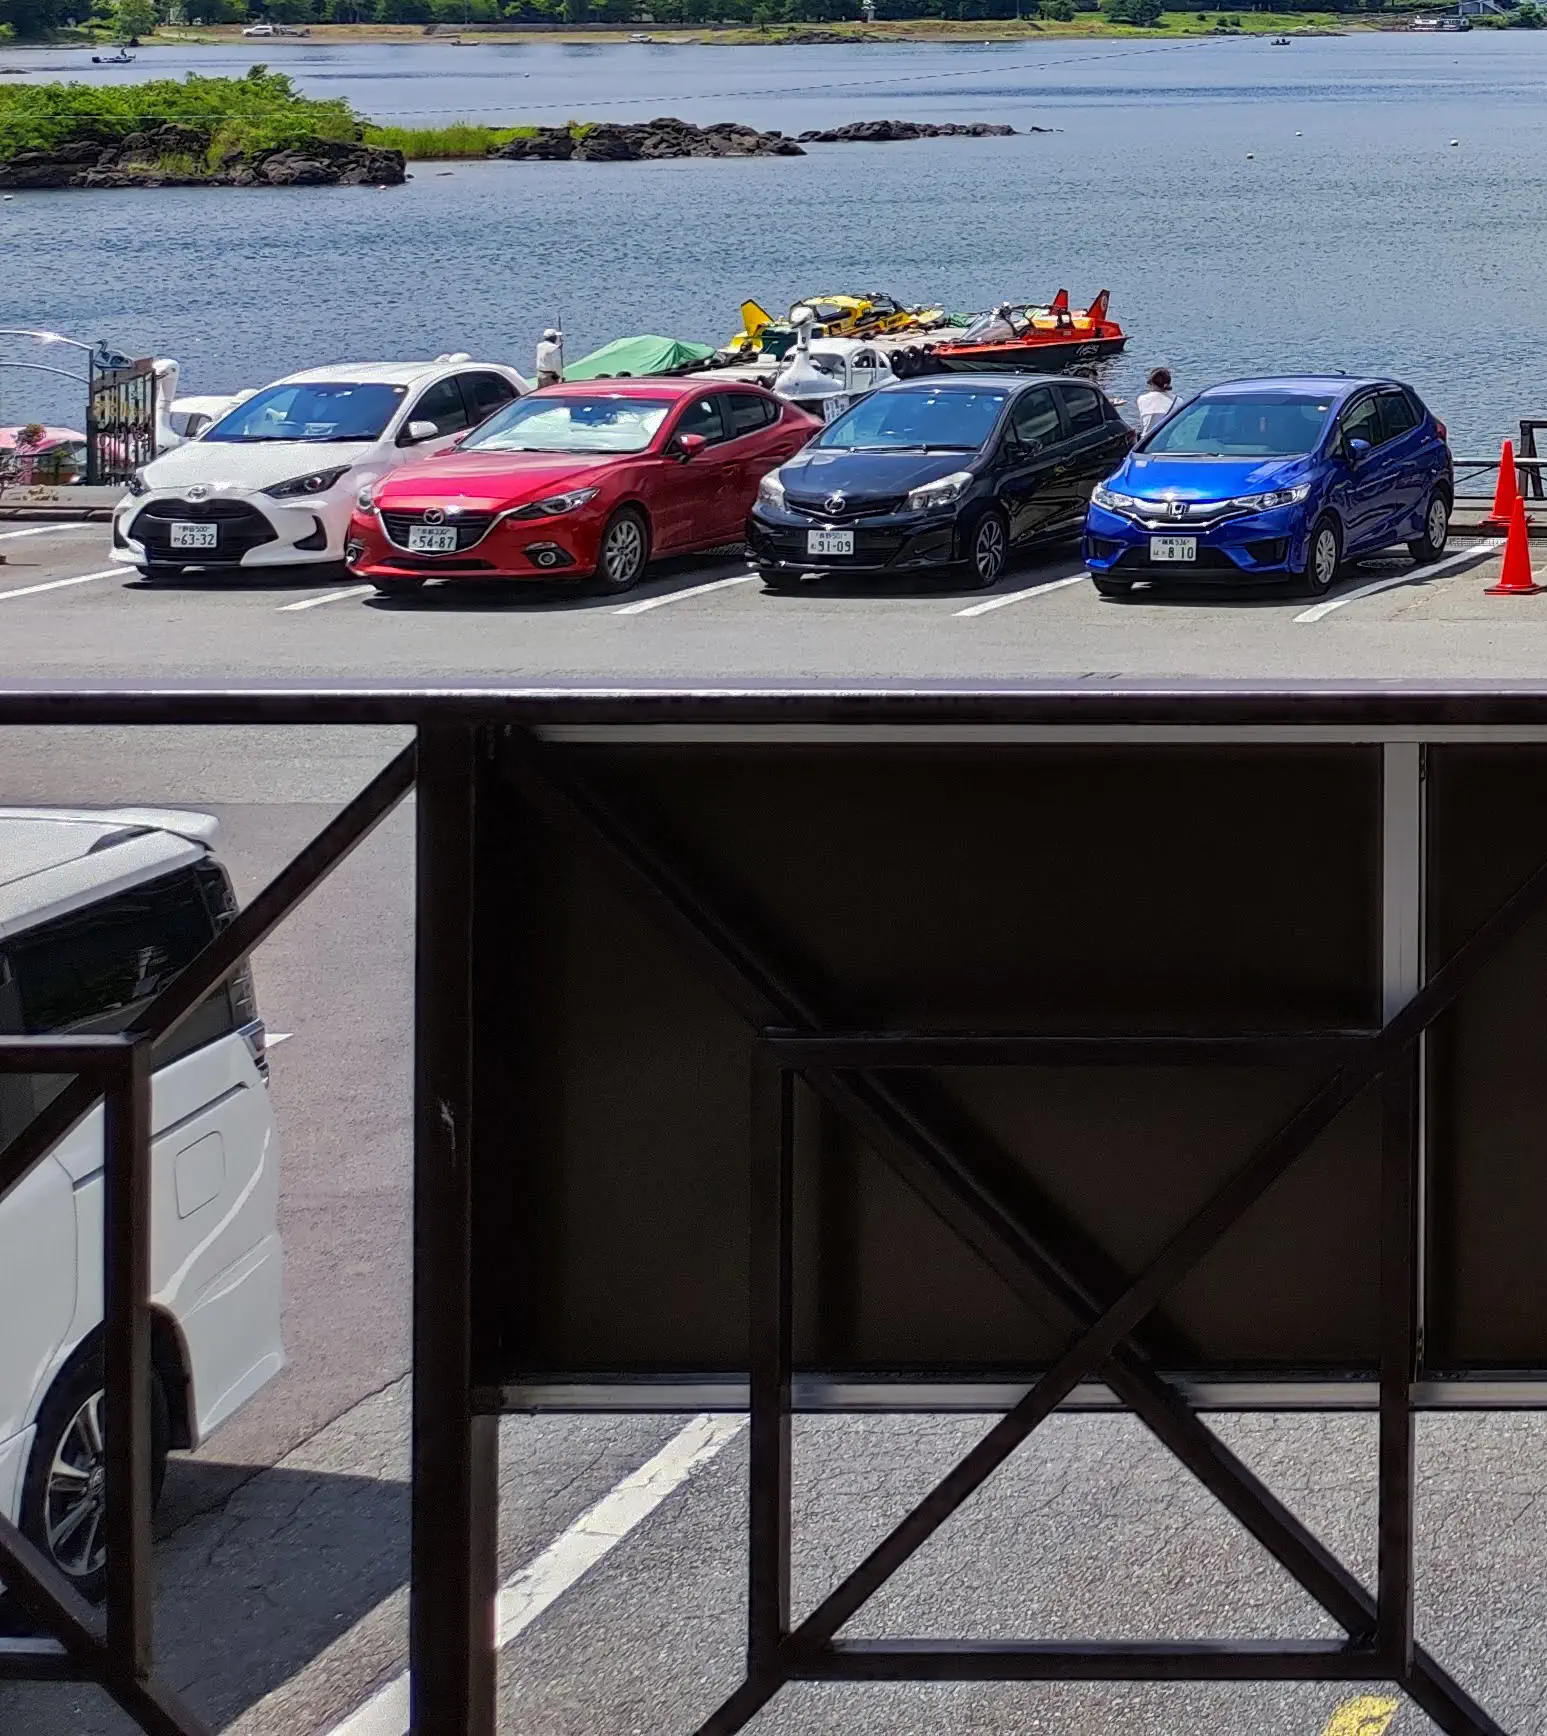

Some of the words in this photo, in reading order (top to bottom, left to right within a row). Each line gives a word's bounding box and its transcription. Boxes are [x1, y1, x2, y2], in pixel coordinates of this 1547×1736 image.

[181, 534, 215, 545] 63-32
[419, 535, 454, 549] 54-87
[818, 540, 851, 551] 91-09
